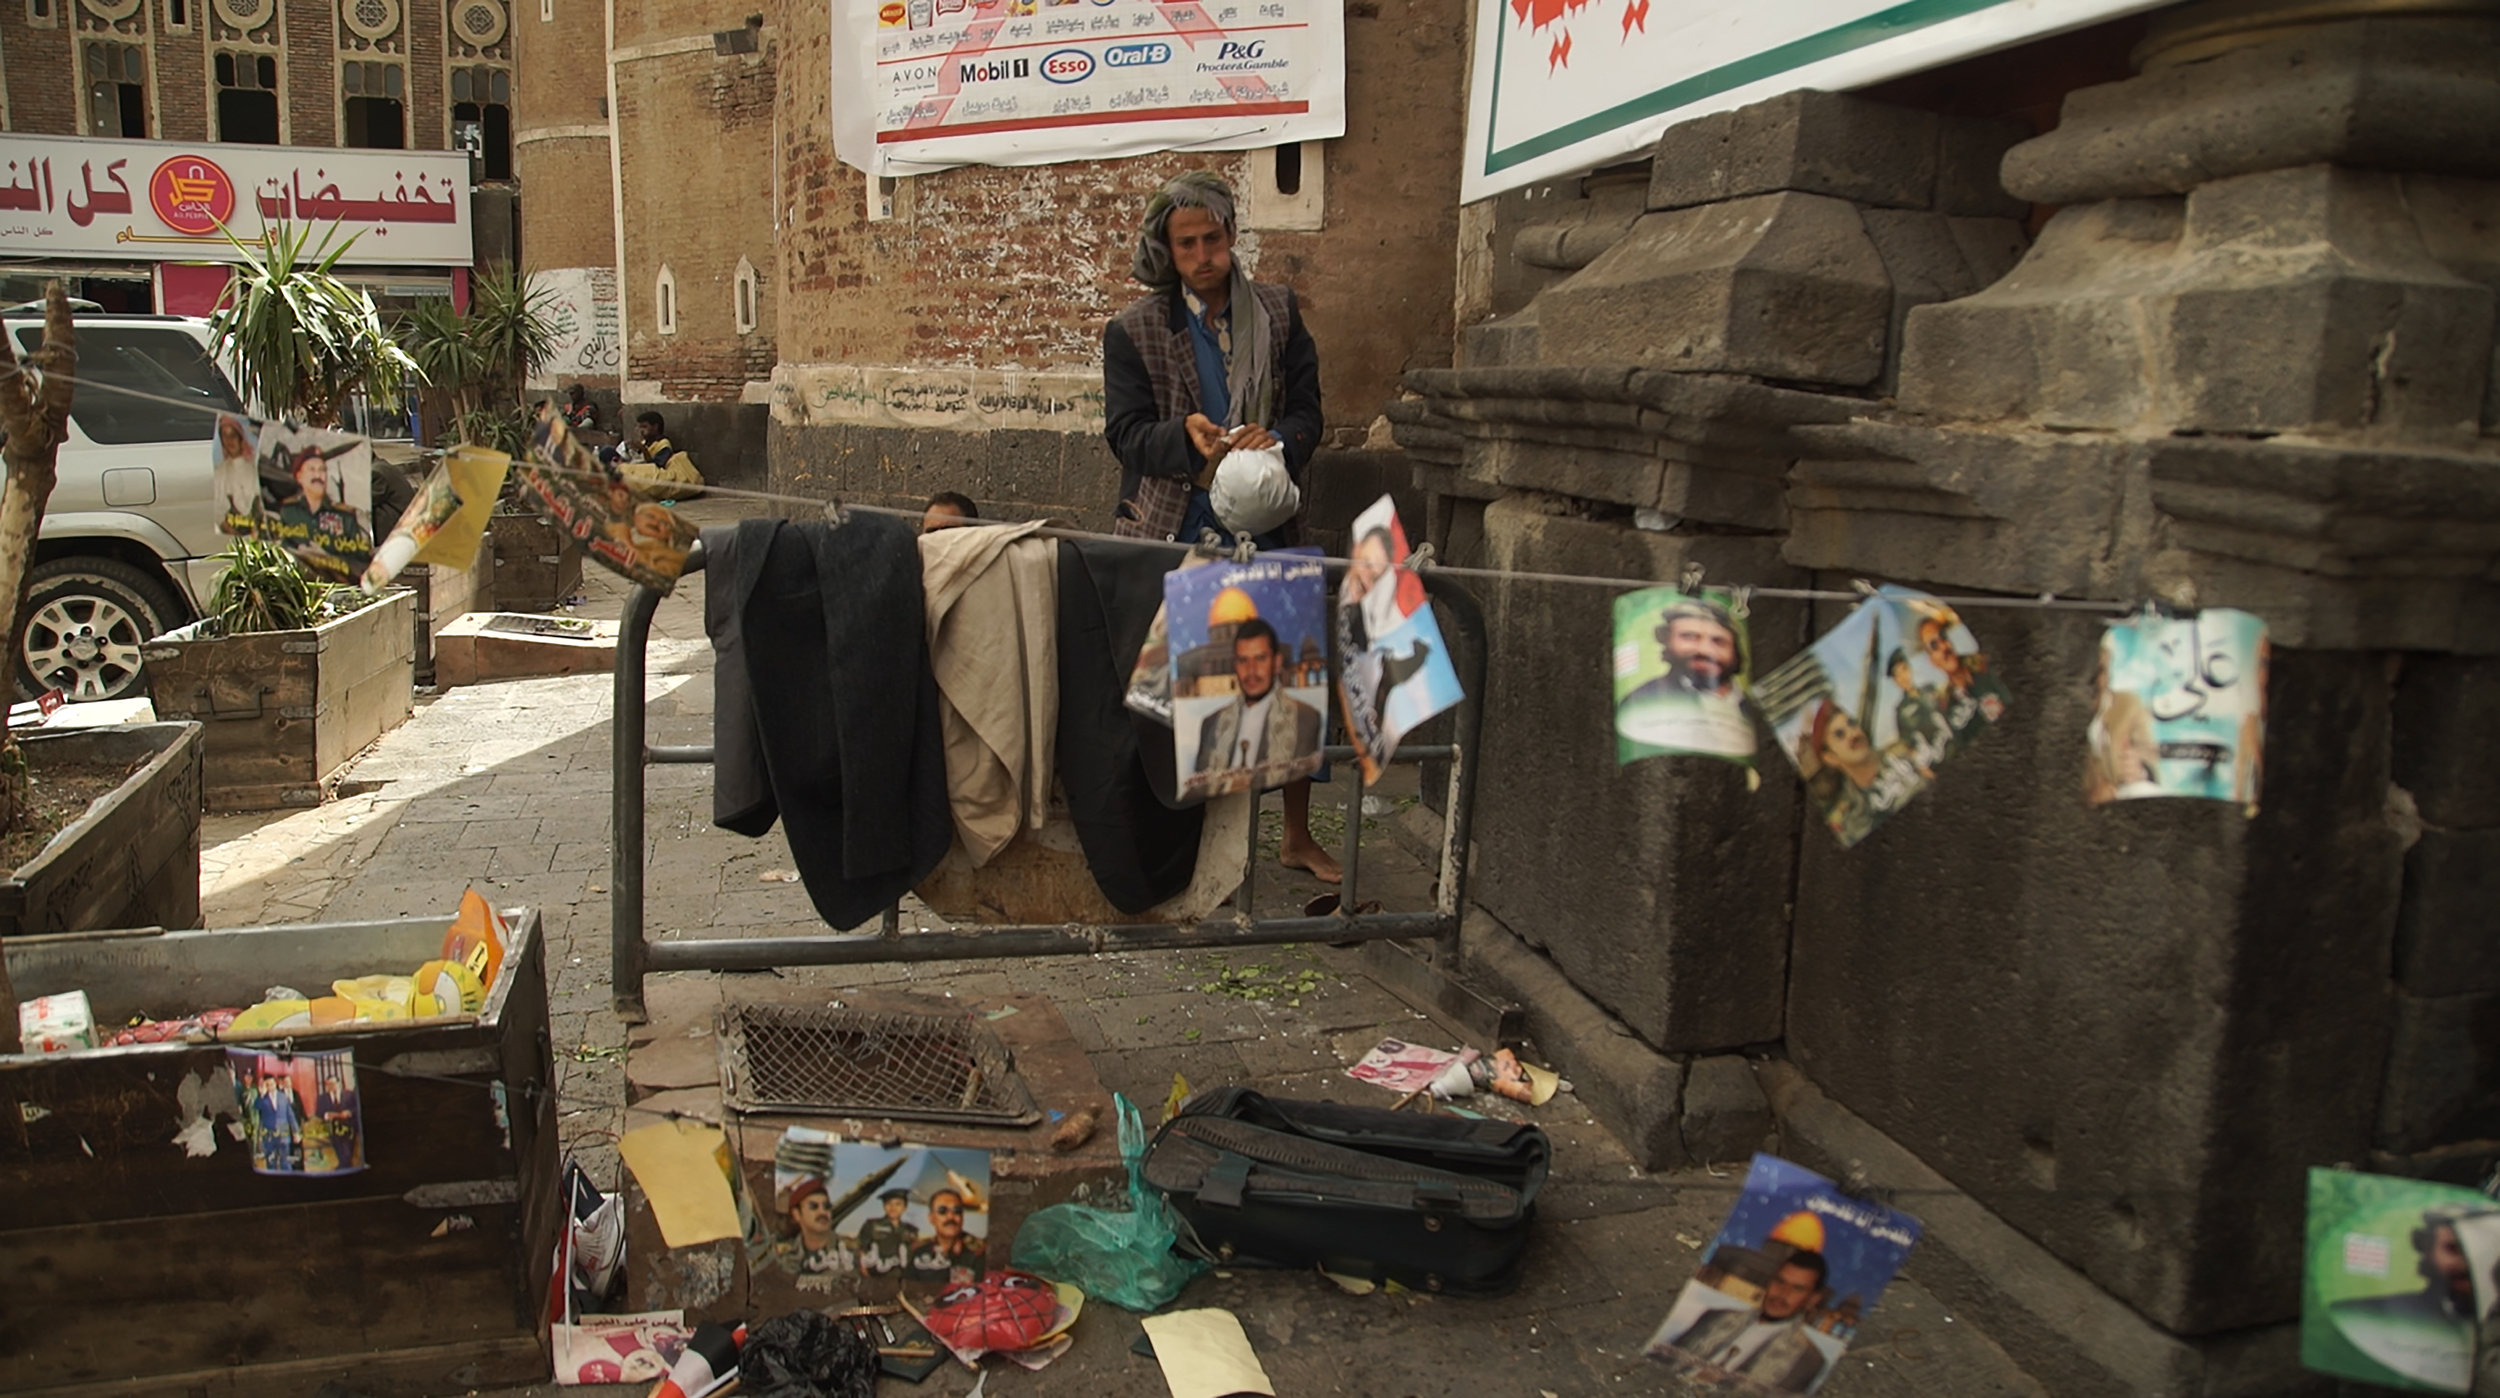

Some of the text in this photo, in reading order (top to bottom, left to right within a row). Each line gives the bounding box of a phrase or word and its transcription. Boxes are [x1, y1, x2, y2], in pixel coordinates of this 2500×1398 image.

[1107, 44, 1169, 65] Oral-B
[1217, 39, 1266, 61] P&G
[893, 66, 937, 83] AVON
[961, 60, 1009, 84] Mobil
[1048, 58, 1088, 75] Esso
[66, 158, 133, 227] كل
[256, 167, 457, 237] تخفيضات
